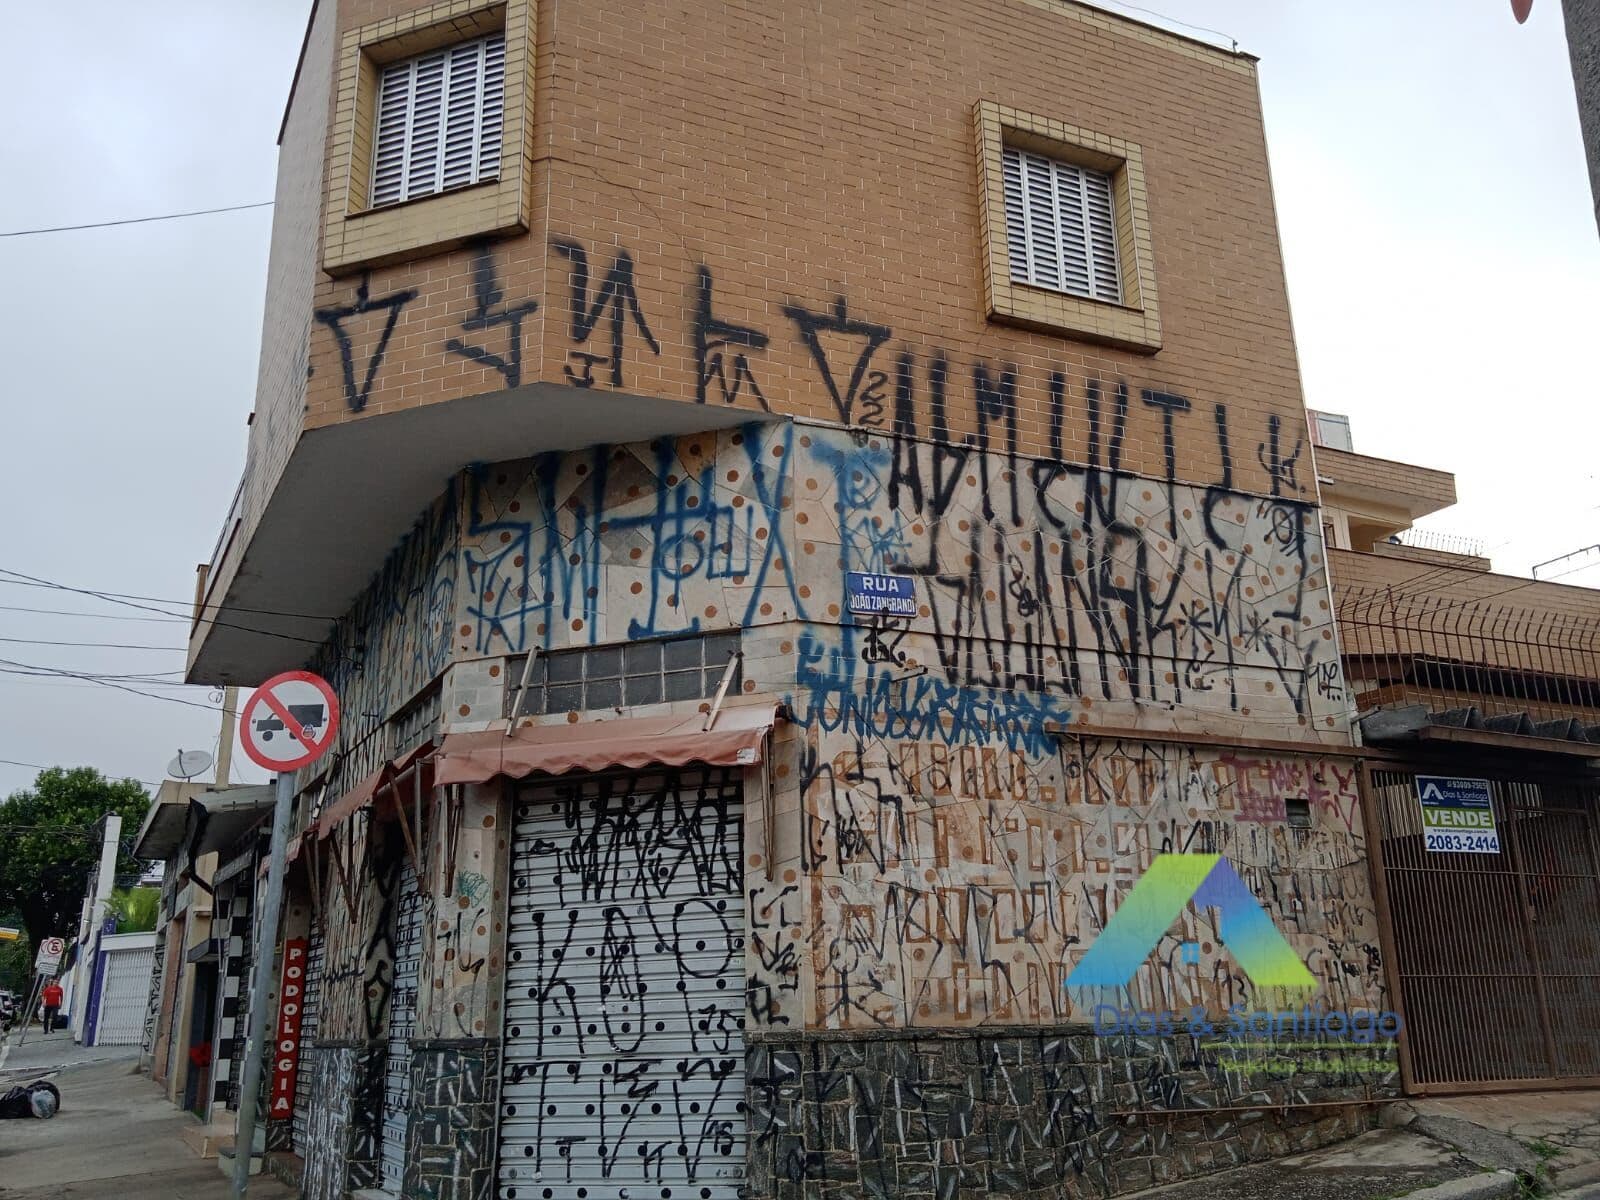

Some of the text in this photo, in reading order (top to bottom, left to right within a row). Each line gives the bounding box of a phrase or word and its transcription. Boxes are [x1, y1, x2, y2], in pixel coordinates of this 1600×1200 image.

[862, 577, 899, 592] RUA
[850, 592, 871, 610] JOÃO
[1425, 810, 1491, 826] VENDE
[1427, 834, 1498, 851] 2083-2414
